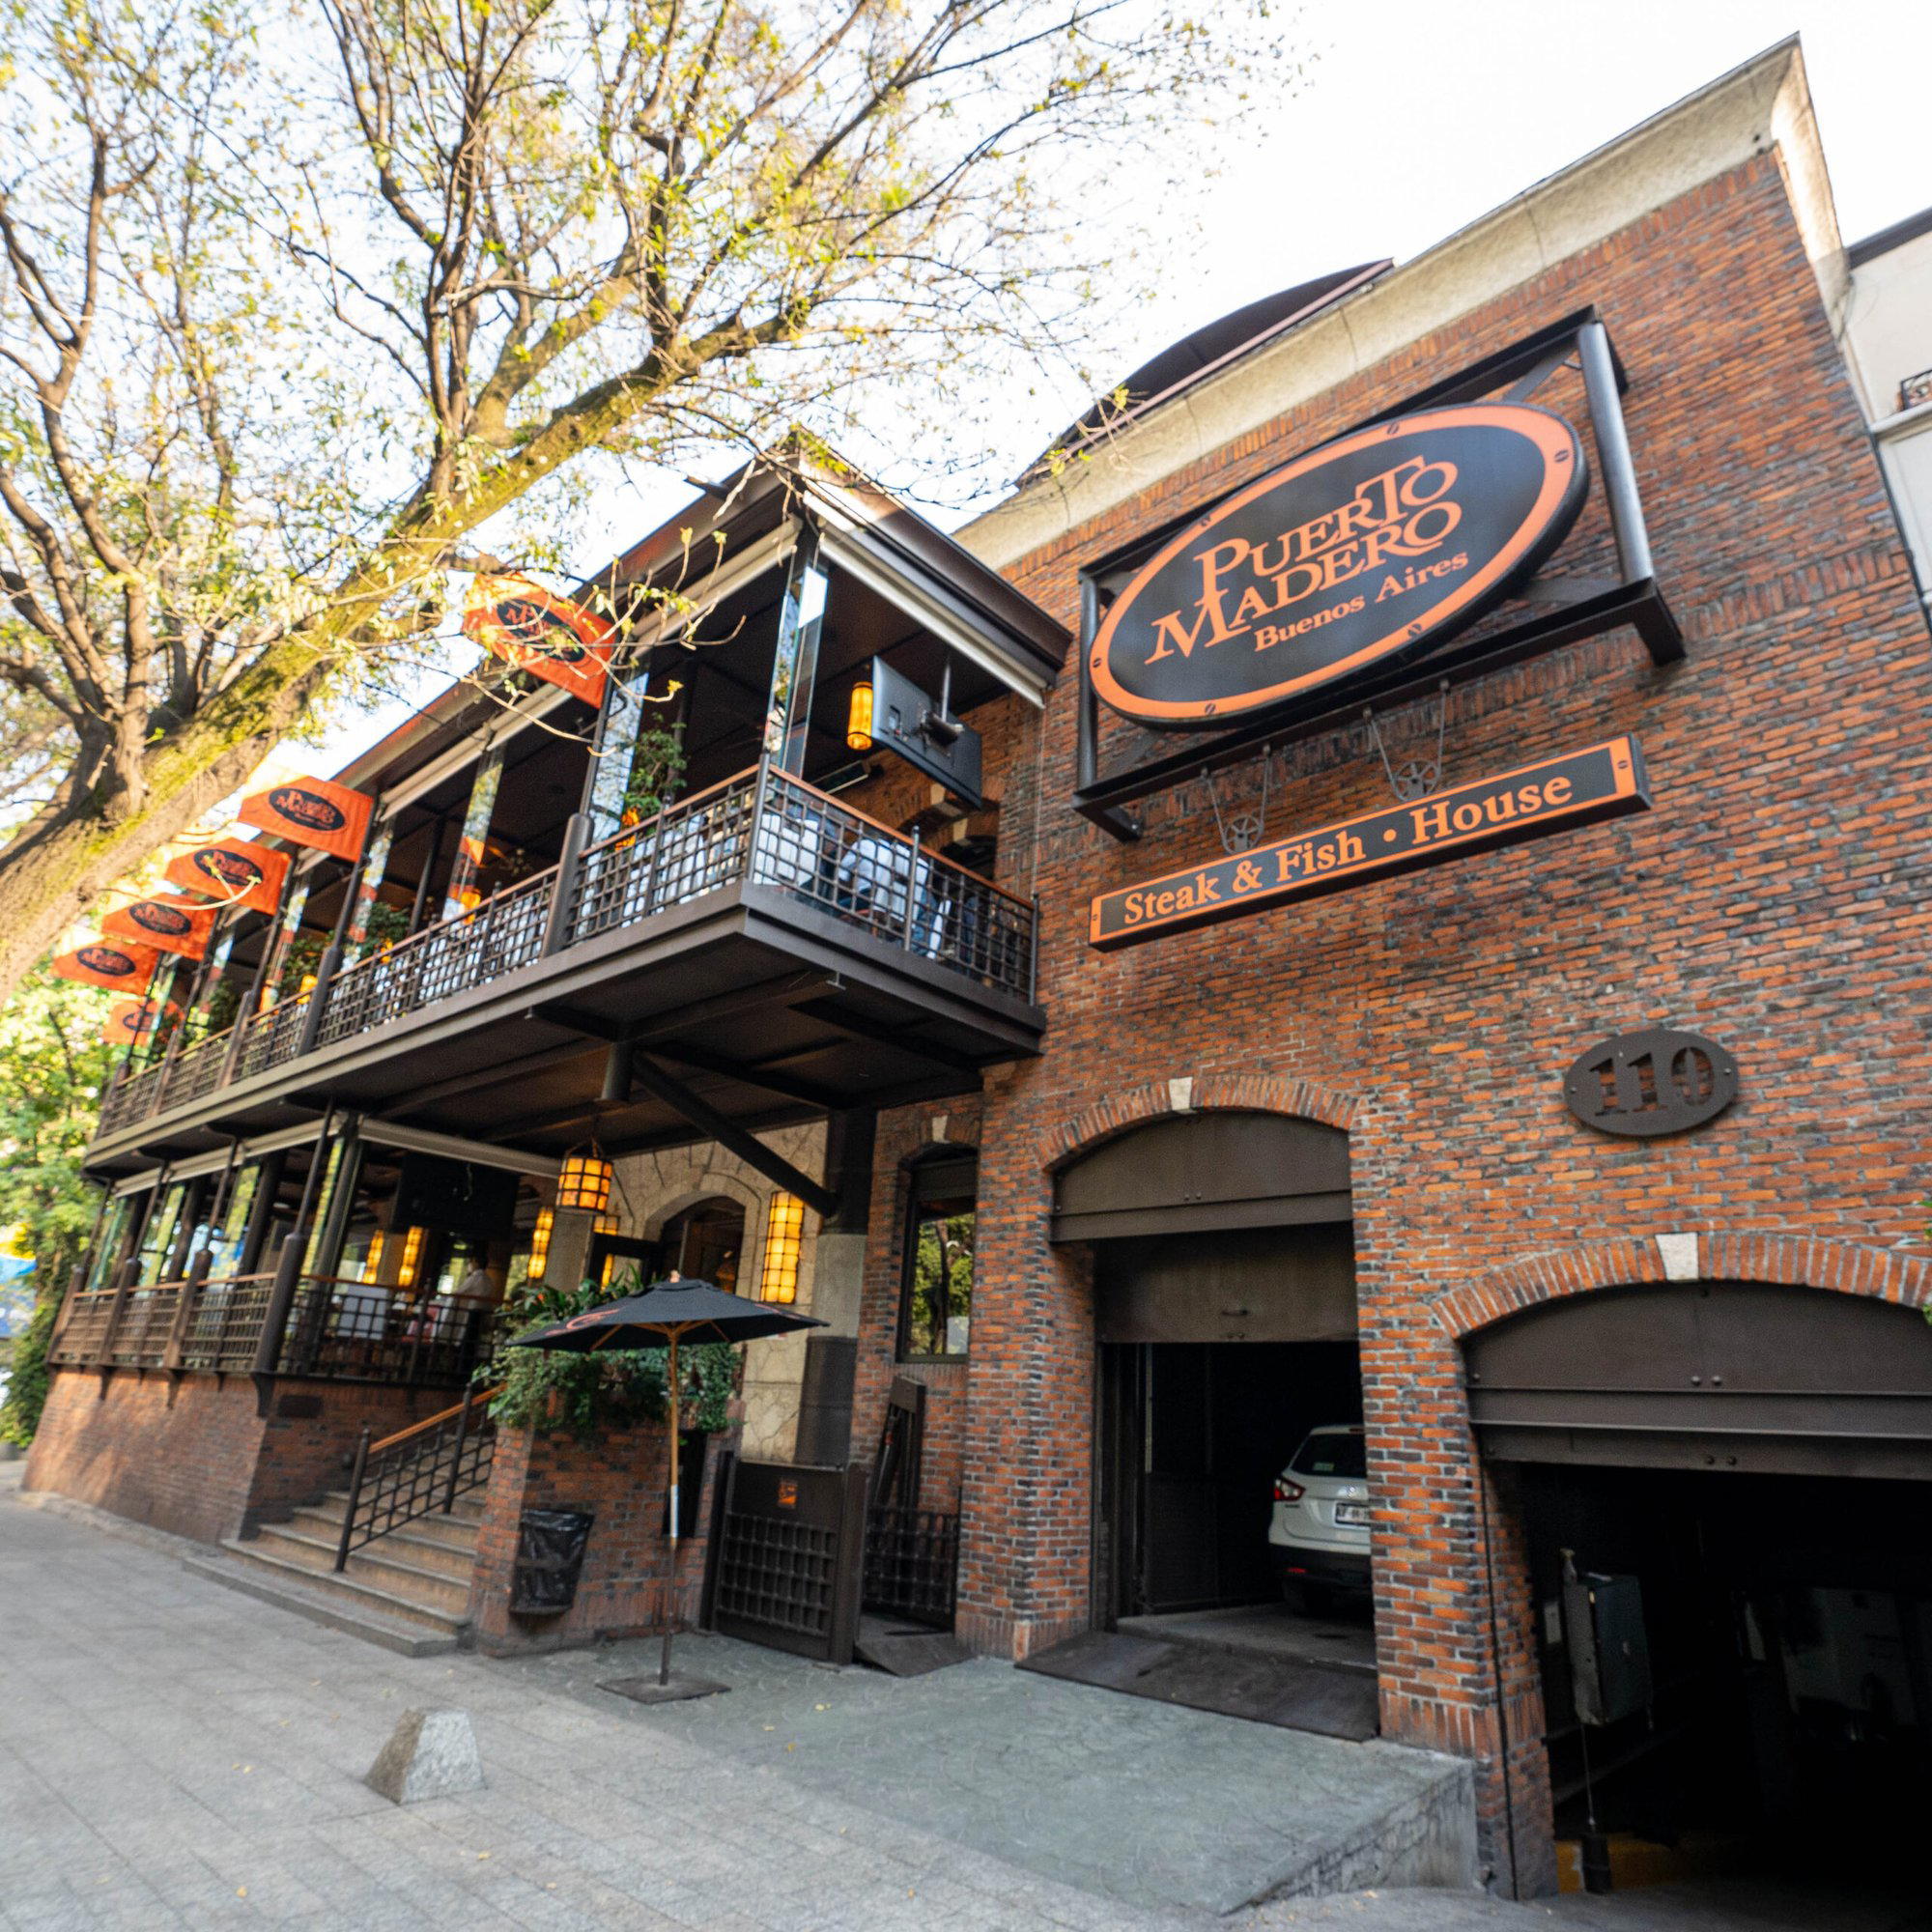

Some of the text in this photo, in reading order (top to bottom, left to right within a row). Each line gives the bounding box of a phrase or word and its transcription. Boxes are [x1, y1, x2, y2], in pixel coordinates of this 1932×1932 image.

[1144, 501, 1463, 664] MADERO
[1194, 455, 1458, 597] PUERTO
[1254, 552, 1469, 652] Buenos Aires
[1124, 776, 1573, 924] Steak & Fish House
[1589, 1046, 1715, 1117] 110
